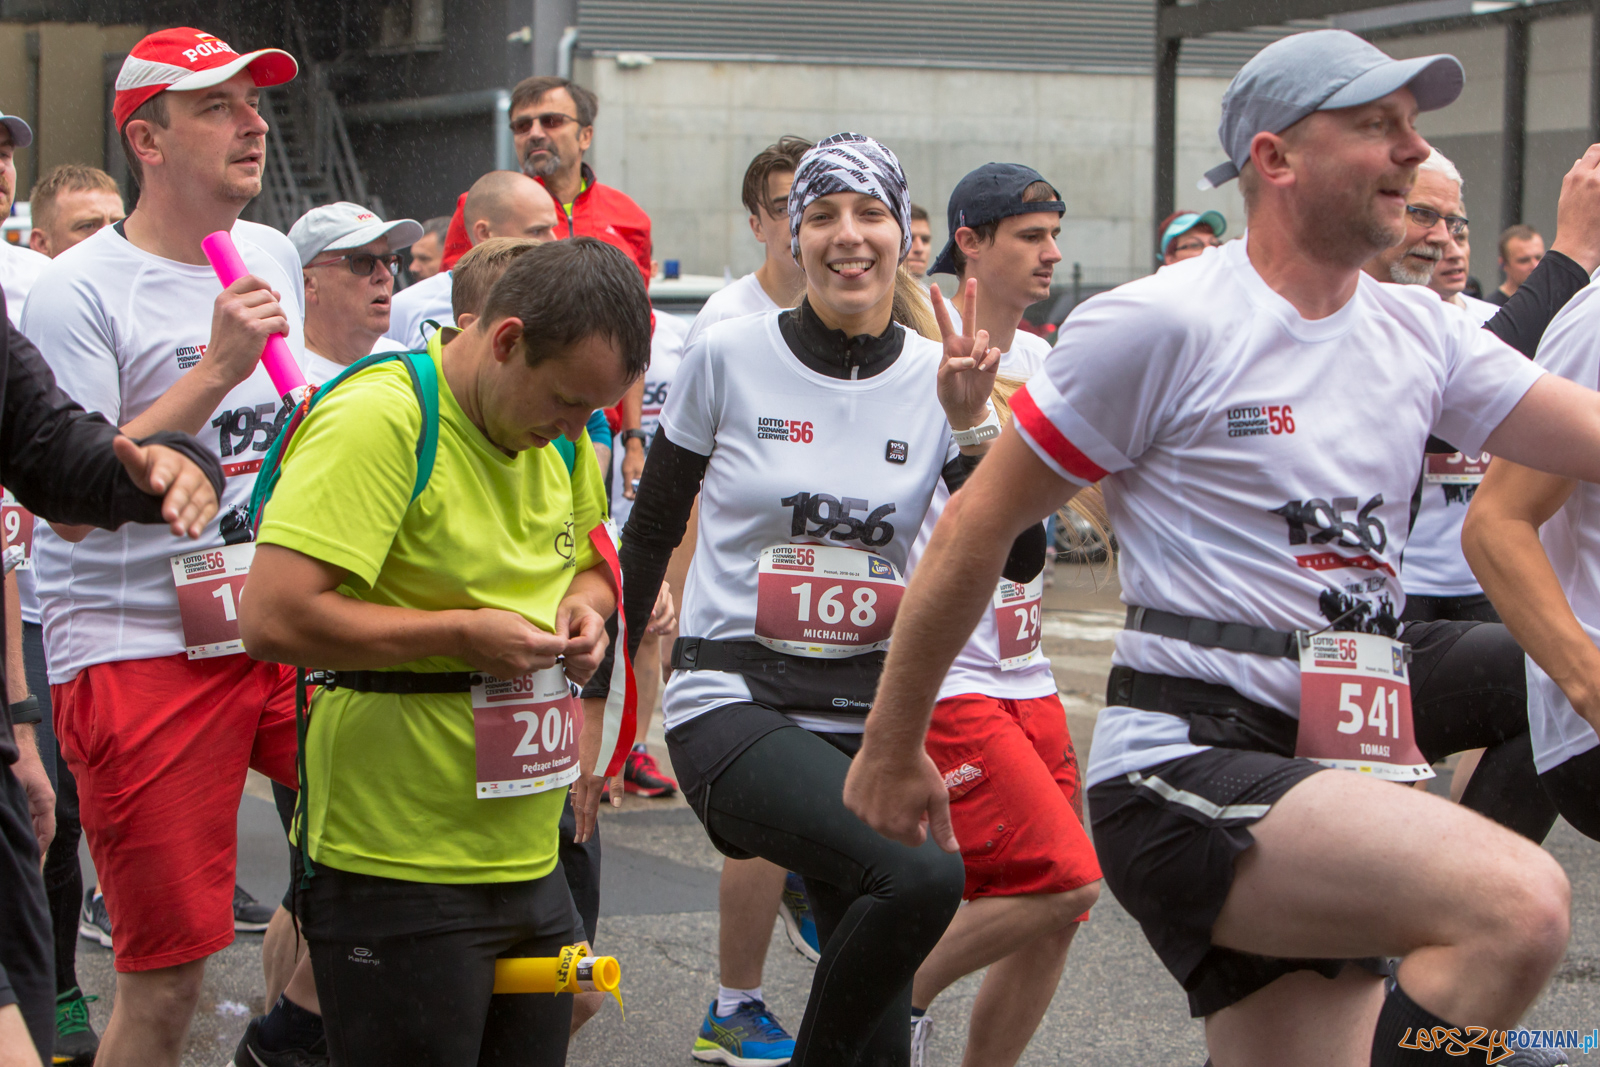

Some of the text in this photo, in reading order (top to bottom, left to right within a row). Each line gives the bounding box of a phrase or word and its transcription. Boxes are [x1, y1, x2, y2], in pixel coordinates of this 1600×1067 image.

[182, 41, 241, 62] POLS
[176, 346, 196, 356] LOTTO
[178, 360, 200, 370] CZERW
[758, 416, 814, 444] LOTTO '56
[1227, 405, 1295, 436] LOTTO '56
[757, 433, 789, 441] CZERWIEC
[1228, 427, 1269, 438] CZERWIEC
[781, 491, 897, 547] 1956
[1267, 492, 1387, 555] 1956
[183, 551, 225, 570] LOTTO '56
[793, 547, 815, 566] '56
[791, 582, 878, 627] 168
[1014, 604, 1041, 640] 29
[803, 628, 860, 641] MICHALINA
[1313, 637, 1357, 661] LOTTO '56
[1337, 682, 1399, 739] 541
[512, 707, 574, 757] 20/1
[1360, 743, 1390, 757] TOMASZ
[522, 761, 552, 774] Pędzące
[347, 955, 380, 966] Kalenji
